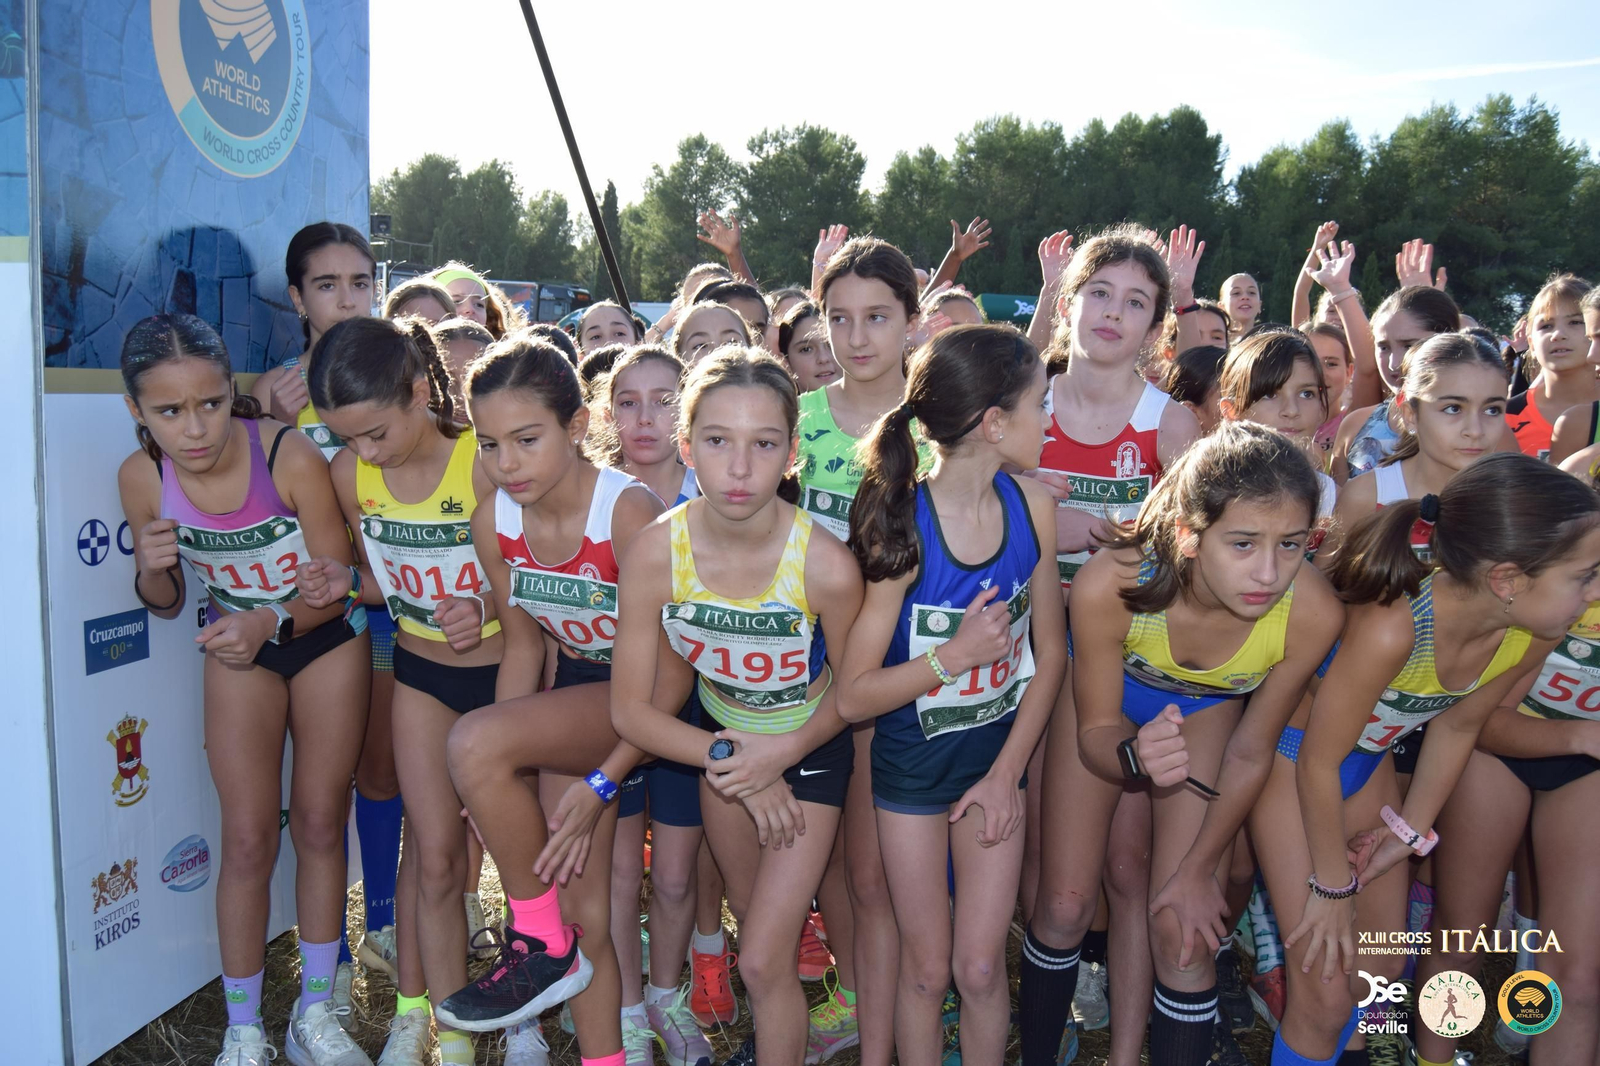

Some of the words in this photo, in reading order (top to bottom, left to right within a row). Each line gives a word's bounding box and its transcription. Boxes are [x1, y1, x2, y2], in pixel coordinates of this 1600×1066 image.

[203, 126, 245, 164] WORLD
[247, 137, 281, 164] CROSS
[280, 69, 305, 141] COUNTRY
[293, 12, 305, 62] TOUR
[214, 59, 261, 92] WORLD
[202, 77, 270, 116] ATHLETICS
[200, 530, 265, 546] ITÁLICA
[388, 523, 446, 541] ITÁLICA
[191, 551, 298, 592] 7113
[382, 557, 483, 601] 5014
[522, 575, 580, 598] ITÁLICA
[90, 620, 144, 645] Cruzcampo
[704, 610, 779, 630] ITÁLICA
[679, 634, 807, 683] 7195
[161, 848, 209, 883] Cazorla
[180, 845, 198, 860] Sierra
[94, 898, 140, 931] INSTITUTO
[95, 911, 141, 951] KIROS
